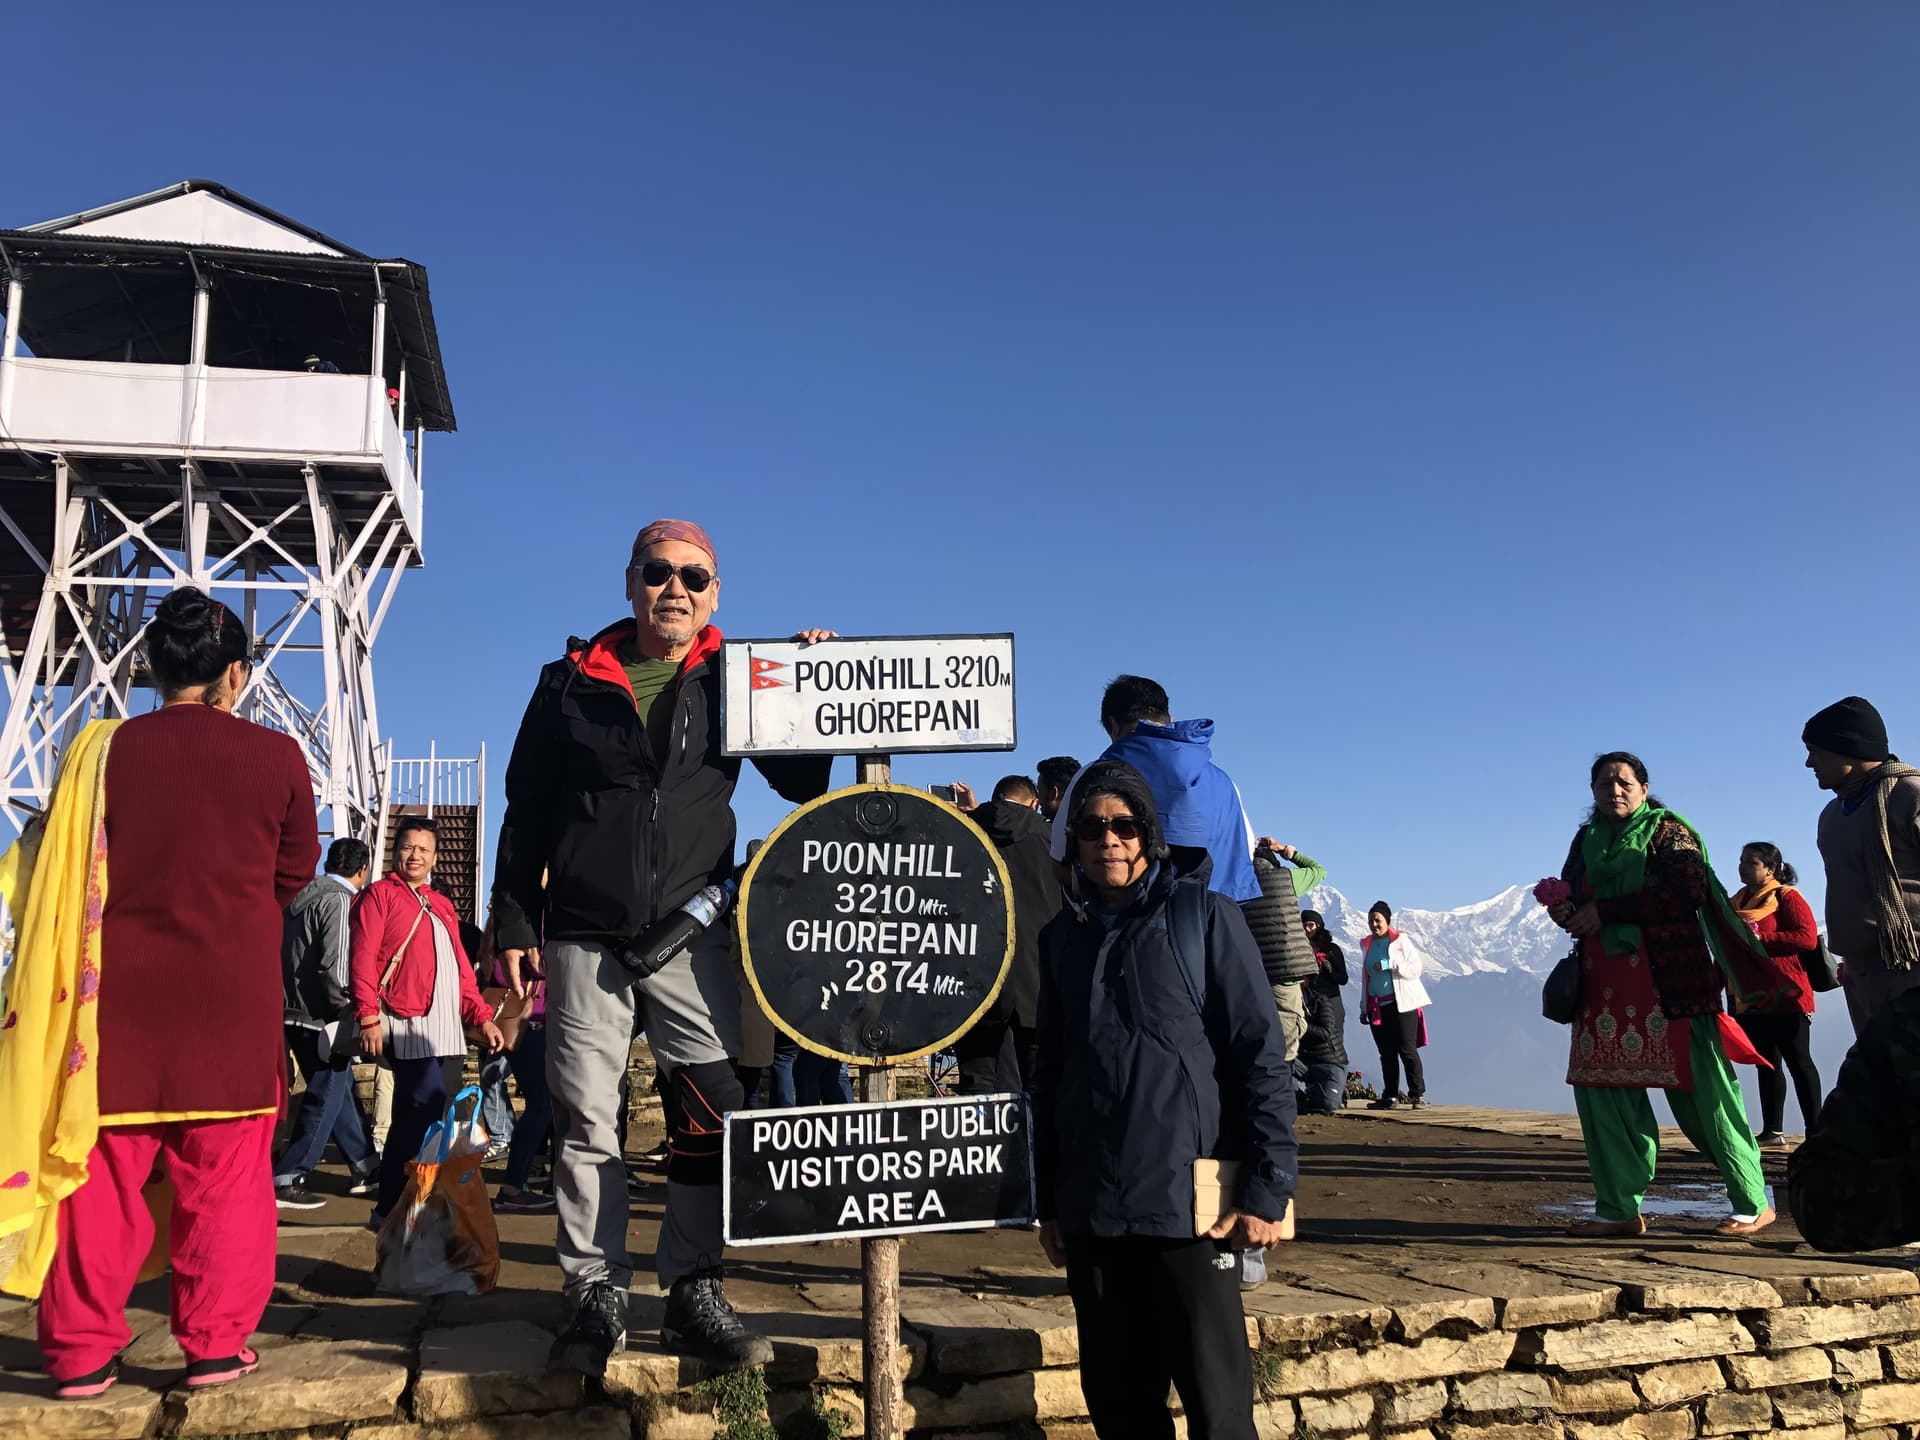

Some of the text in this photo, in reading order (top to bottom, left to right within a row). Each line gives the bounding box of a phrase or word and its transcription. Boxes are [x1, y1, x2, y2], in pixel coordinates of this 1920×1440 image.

[815, 699, 981, 736] GHOREPANI
[834, 882, 949, 916] 3210 Mtr.
[786, 919, 977, 955] GHOREPANI
[845, 959, 965, 996] 2874 Mtr.
[753, 1102, 1019, 1153] POON HILL PUBLIC
[768, 1144, 1003, 1191] VISITORS PARK
[837, 1189, 946, 1226] AREA
